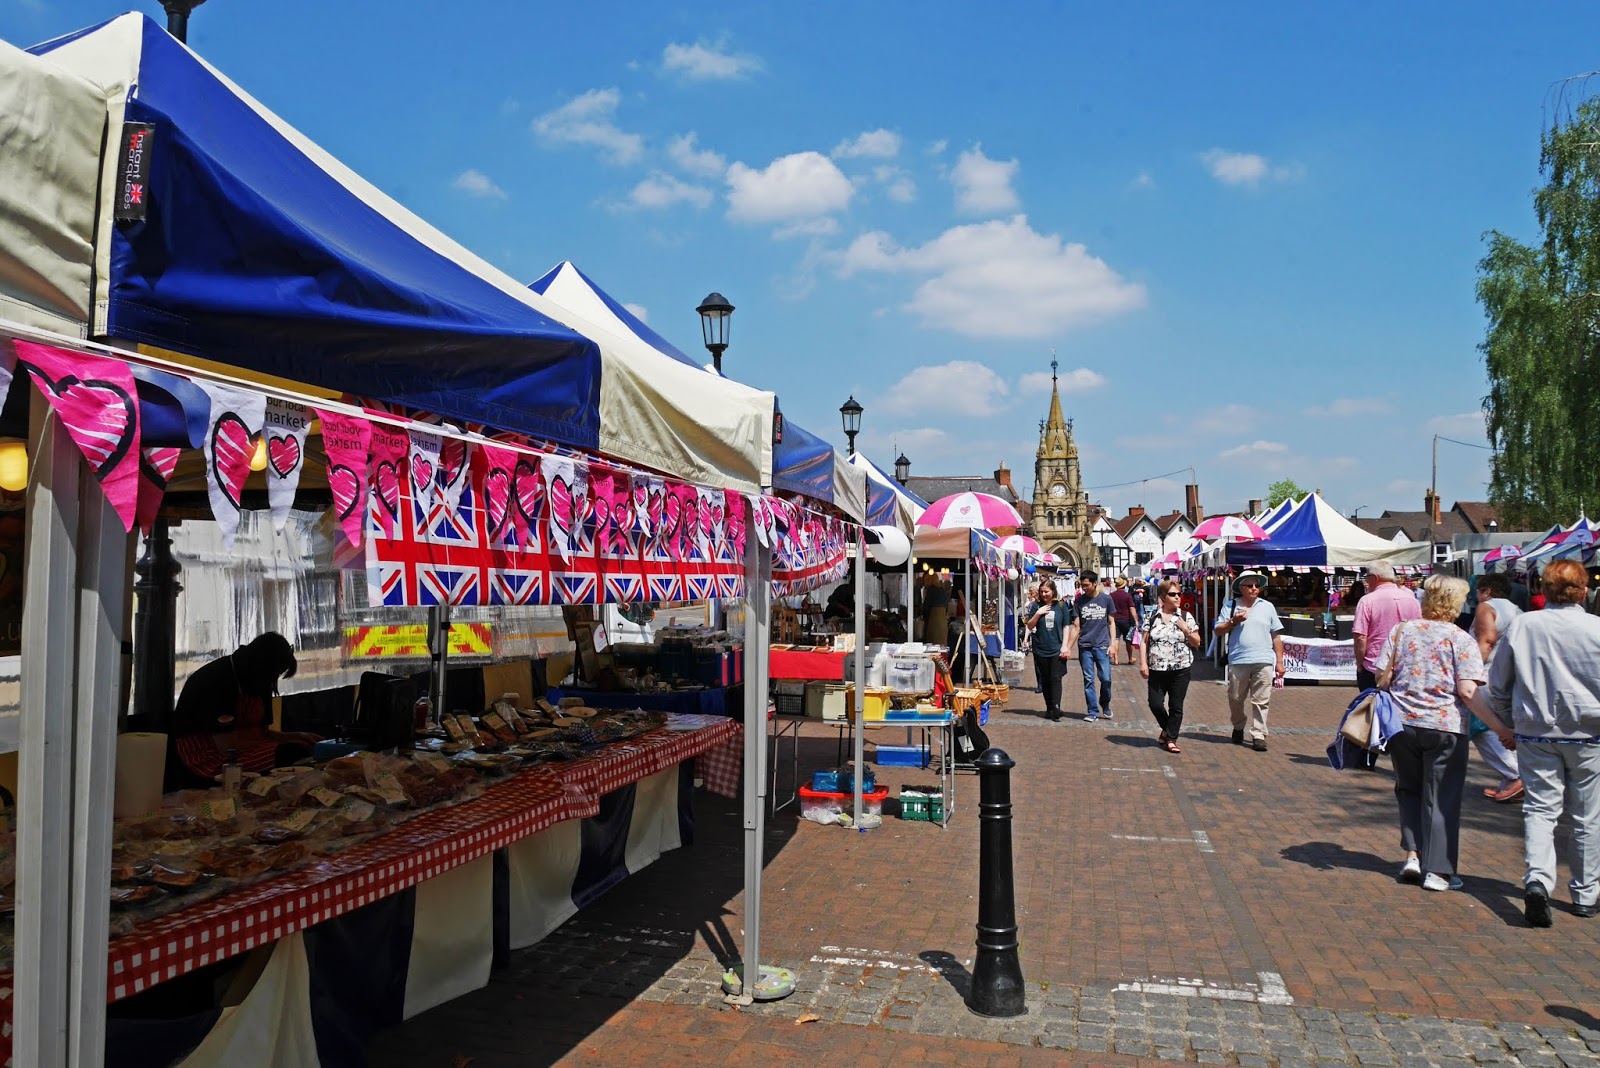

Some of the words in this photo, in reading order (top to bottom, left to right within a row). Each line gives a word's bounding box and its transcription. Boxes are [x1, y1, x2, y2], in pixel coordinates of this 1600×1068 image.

[133, 130, 148, 179] instant
[373, 432, 405, 449] market
[1284, 643, 1309, 652] OOT
[1282, 651, 1308, 659] RINTS
[1284, 659, 1307, 667] INYL
